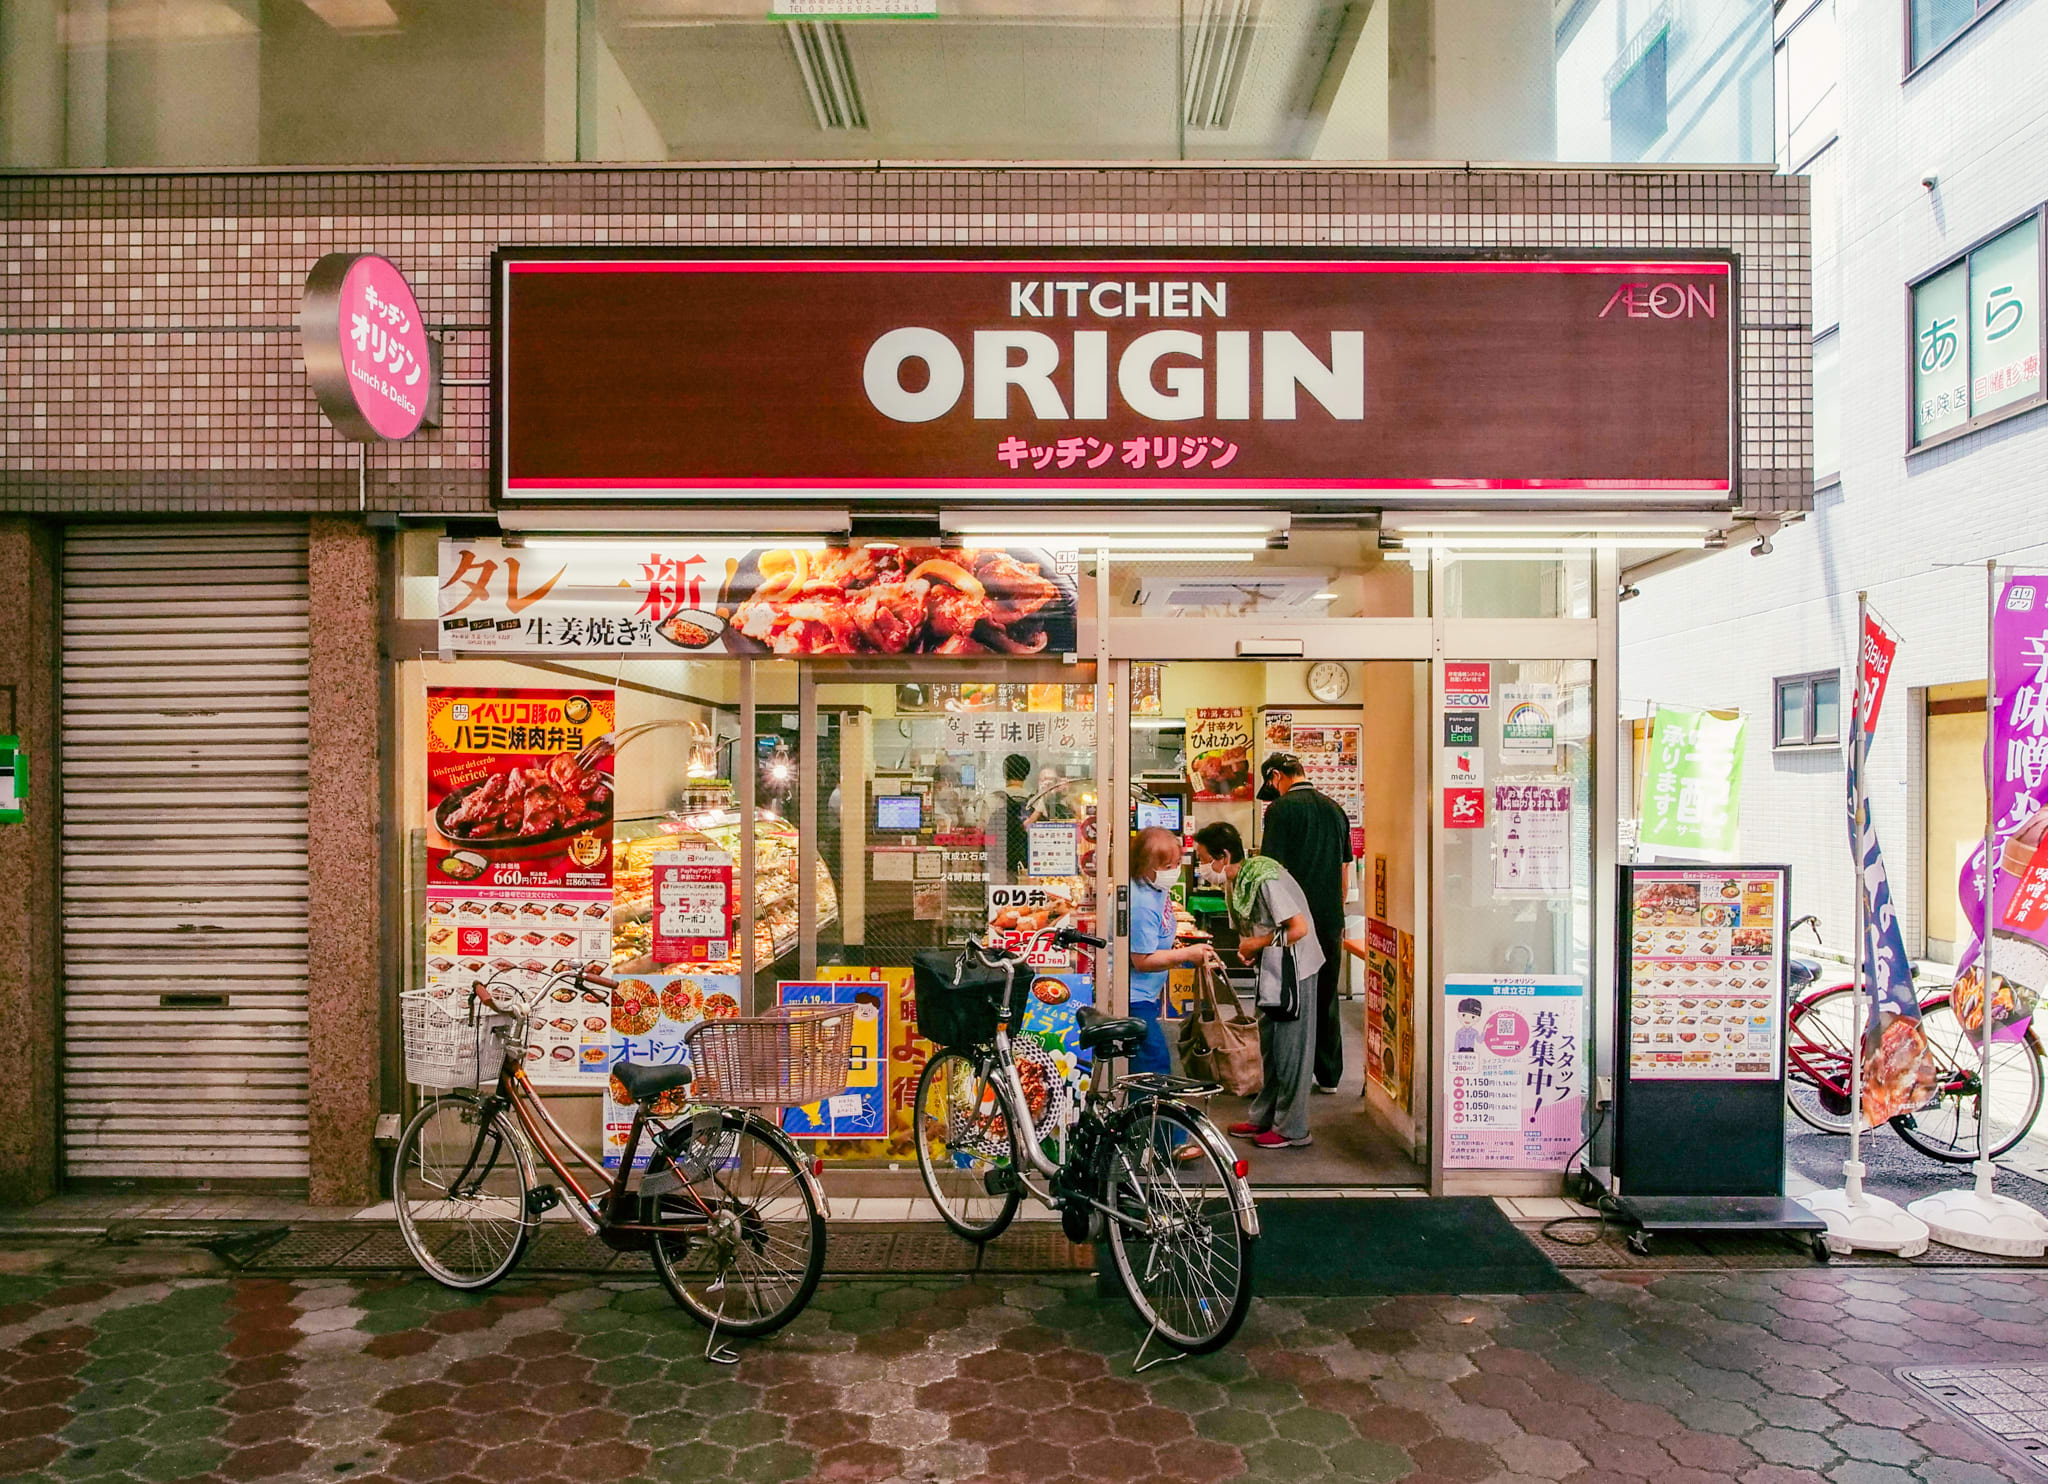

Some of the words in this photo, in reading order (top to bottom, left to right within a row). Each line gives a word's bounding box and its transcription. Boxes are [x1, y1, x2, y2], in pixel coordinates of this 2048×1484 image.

[364, 284, 410, 334] キッチン
[1010, 281, 1227, 318] KITCHEN
[350, 313, 421, 386] オリジン
[862, 326, 1365, 423] ORIGIN
[351, 359, 380, 392] Lunch
[380, 380, 389, 396] &
[389, 385, 416, 416] Delica
[1920, 384, 1967, 426] 保険医
[997, 435, 1115, 470] キッチン
[1120, 435, 1239, 470] オリジン
[1445, 694, 1488, 705] SECOM
[471, 703, 562, 724] イベリコ豚の
[1207, 721, 1243, 732] 甘辛タレ
[1450, 724, 1473, 734] Uber
[1450, 734, 1473, 742] Eats
[454, 726, 584, 751] ハラミ焼肉弁当
[1190, 733, 1248, 749] ひれかつ
[432, 764, 465, 777] Disfrutar
[465, 759, 477, 769] del
[476, 755, 497, 767] cerdo
[448, 766, 489, 786] ibérico!
[992, 889, 1046, 907] のり弁
[1492, 986, 1536, 995] 京成立石店
[1526, 1010, 1560, 1123] 募集中!
[1555, 1034, 1577, 1102] スタッフ
